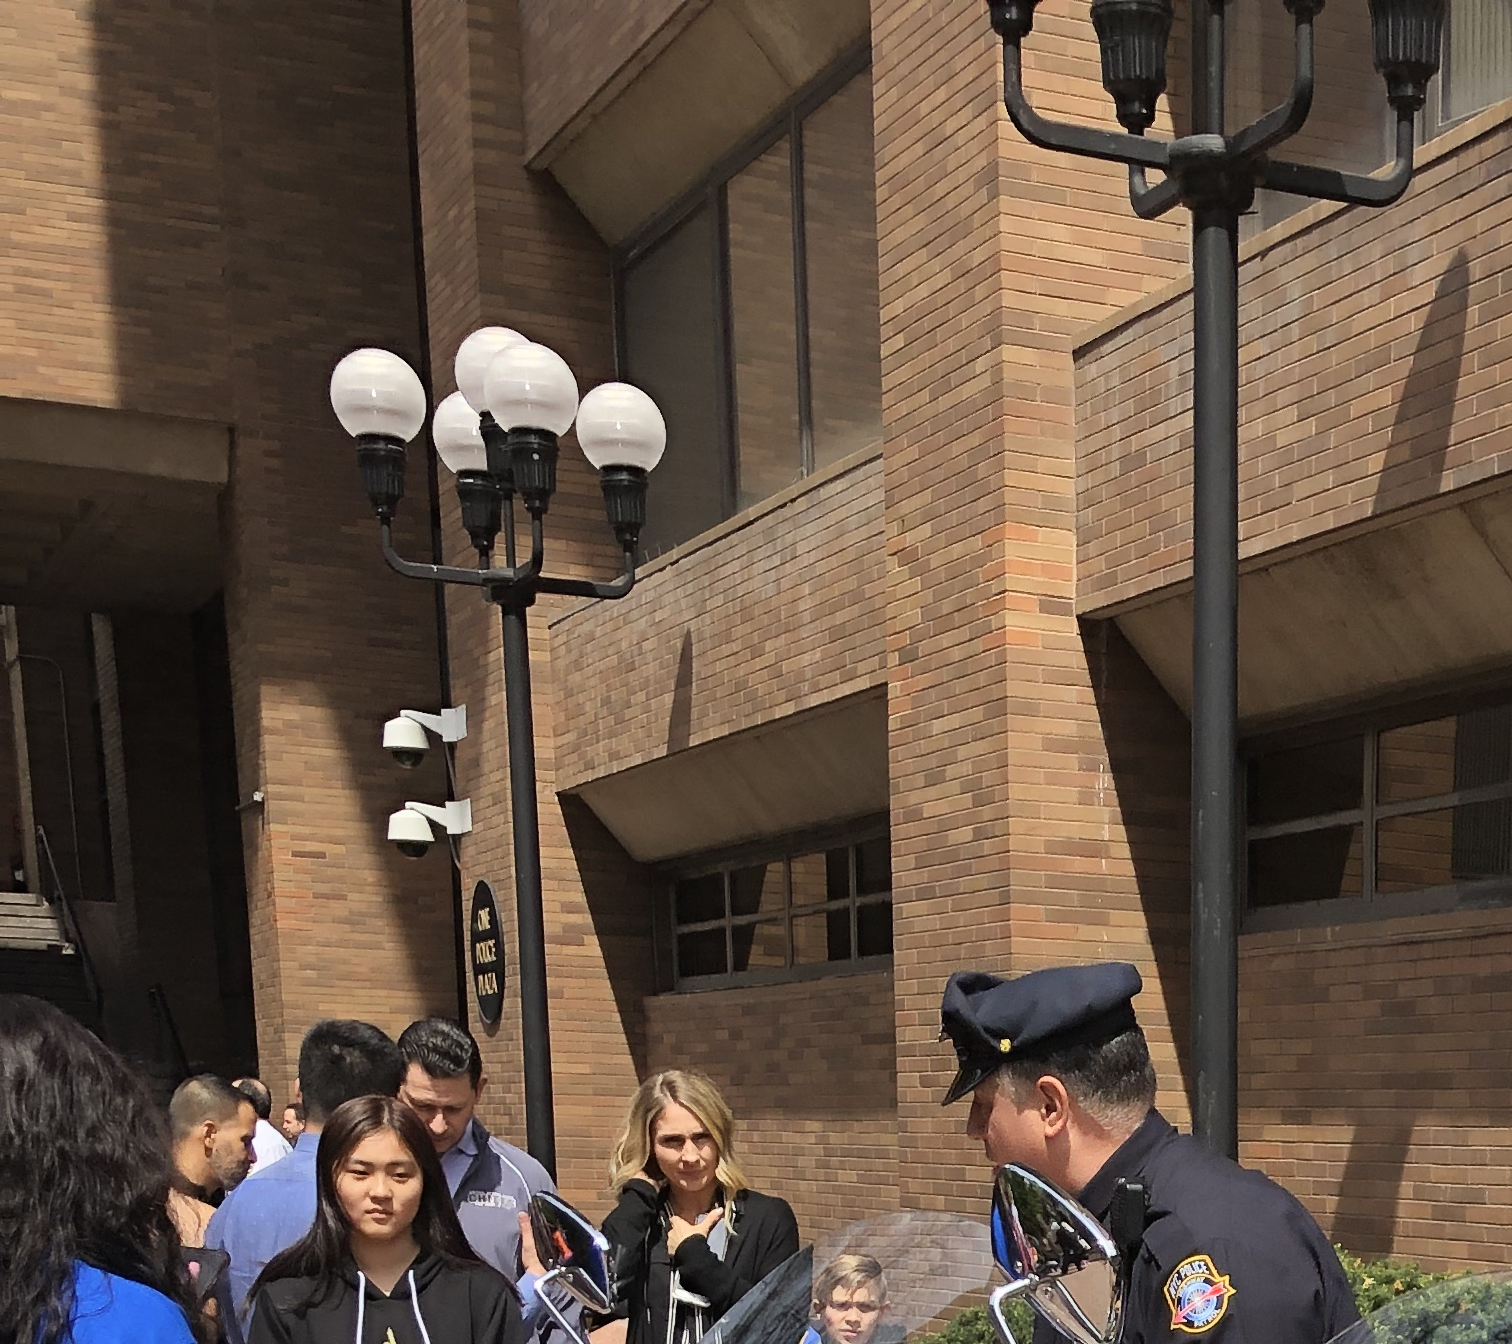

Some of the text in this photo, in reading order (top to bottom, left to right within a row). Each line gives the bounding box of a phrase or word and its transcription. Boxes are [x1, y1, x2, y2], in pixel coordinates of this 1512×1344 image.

[478, 907, 491, 931] ONE
[476, 939, 497, 964] POLICE
[478, 972, 498, 996] PLAZA
[1180, 1261, 1209, 1279] POLICE
